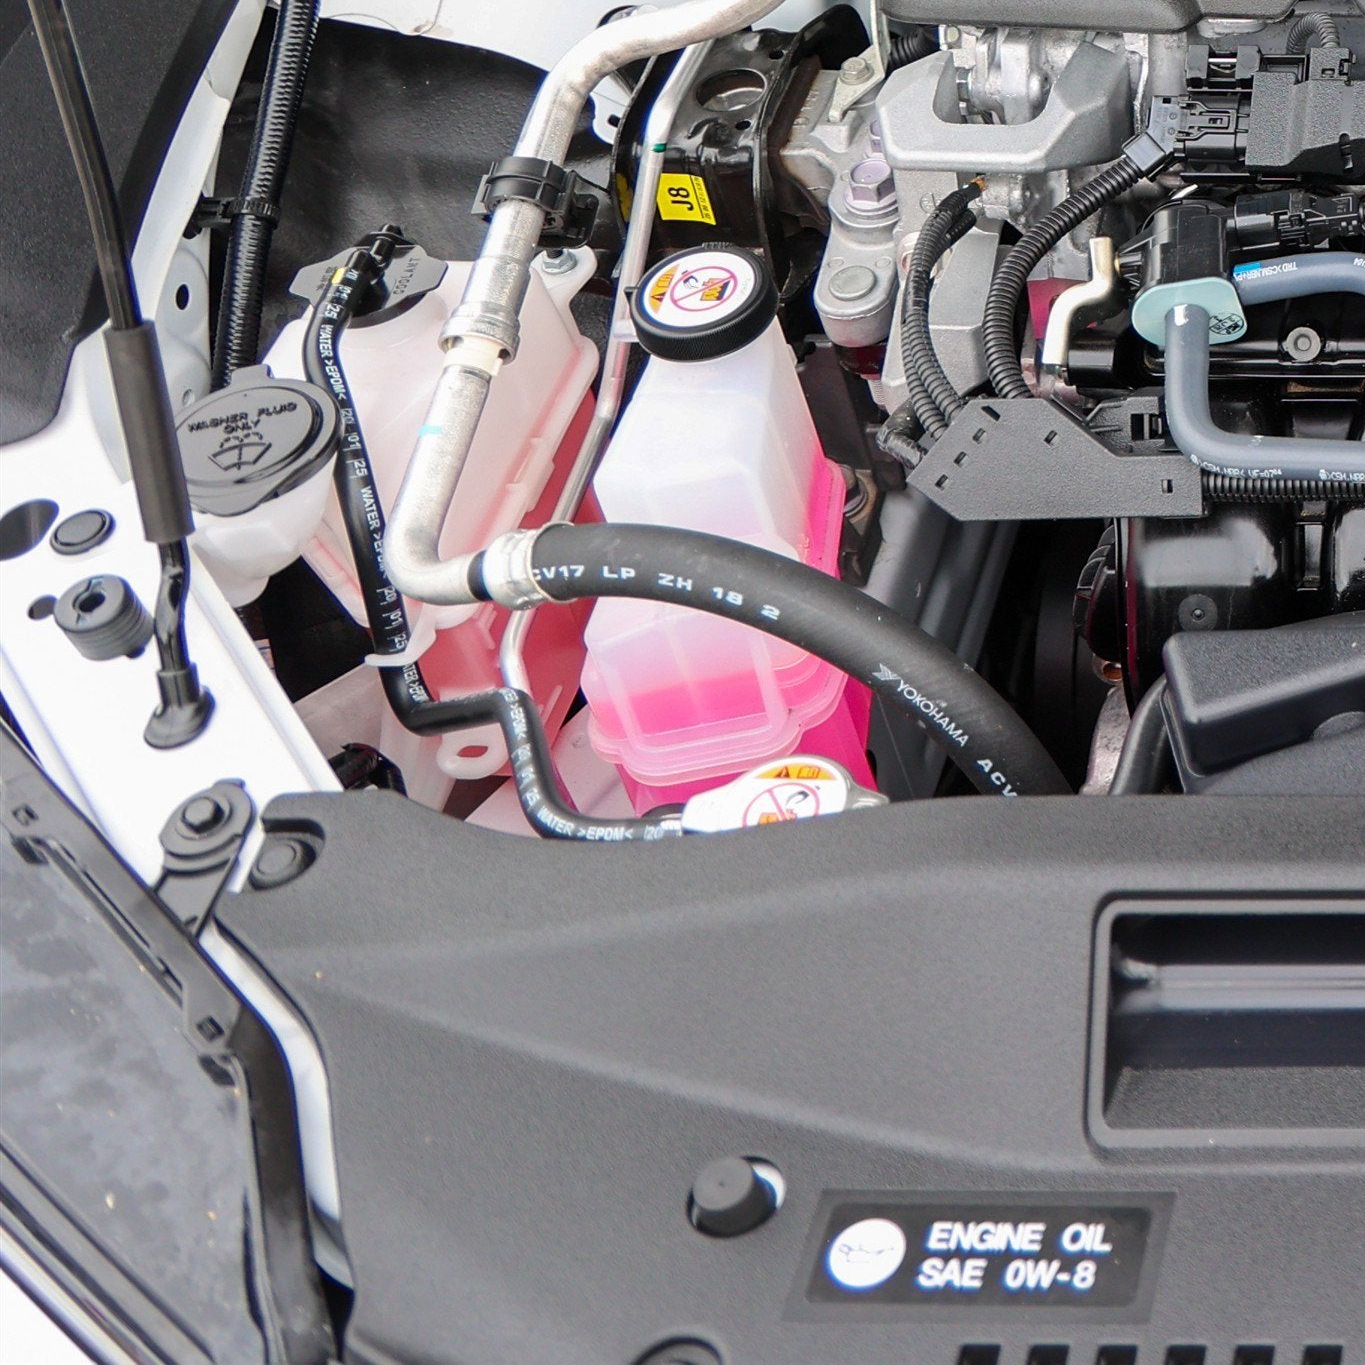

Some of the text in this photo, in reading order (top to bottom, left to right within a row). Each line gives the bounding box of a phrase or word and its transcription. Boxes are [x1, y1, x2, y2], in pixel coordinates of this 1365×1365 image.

[668, 187, 694, 211] J8
[319, 325, 334, 358] WATER
[188, 401, 298, 433] WASHER FLUID
[223, 419, 261, 433] ONLY
[360, 486, 381, 531] WATER
[603, 566, 636, 579] LP
[658, 573, 693, 591] ZH
[711, 587, 743, 606] 18
[761, 604, 781, 620] 2
[897, 679, 1018, 797] YOKOHAMA ACV
[536, 805, 575, 836] WATER
[577, 827, 634, 841] >EPDM<
[926, 1222, 1113, 1253] ENGINE OIL
[917, 1259, 1096, 1291] SAE 0W-8
